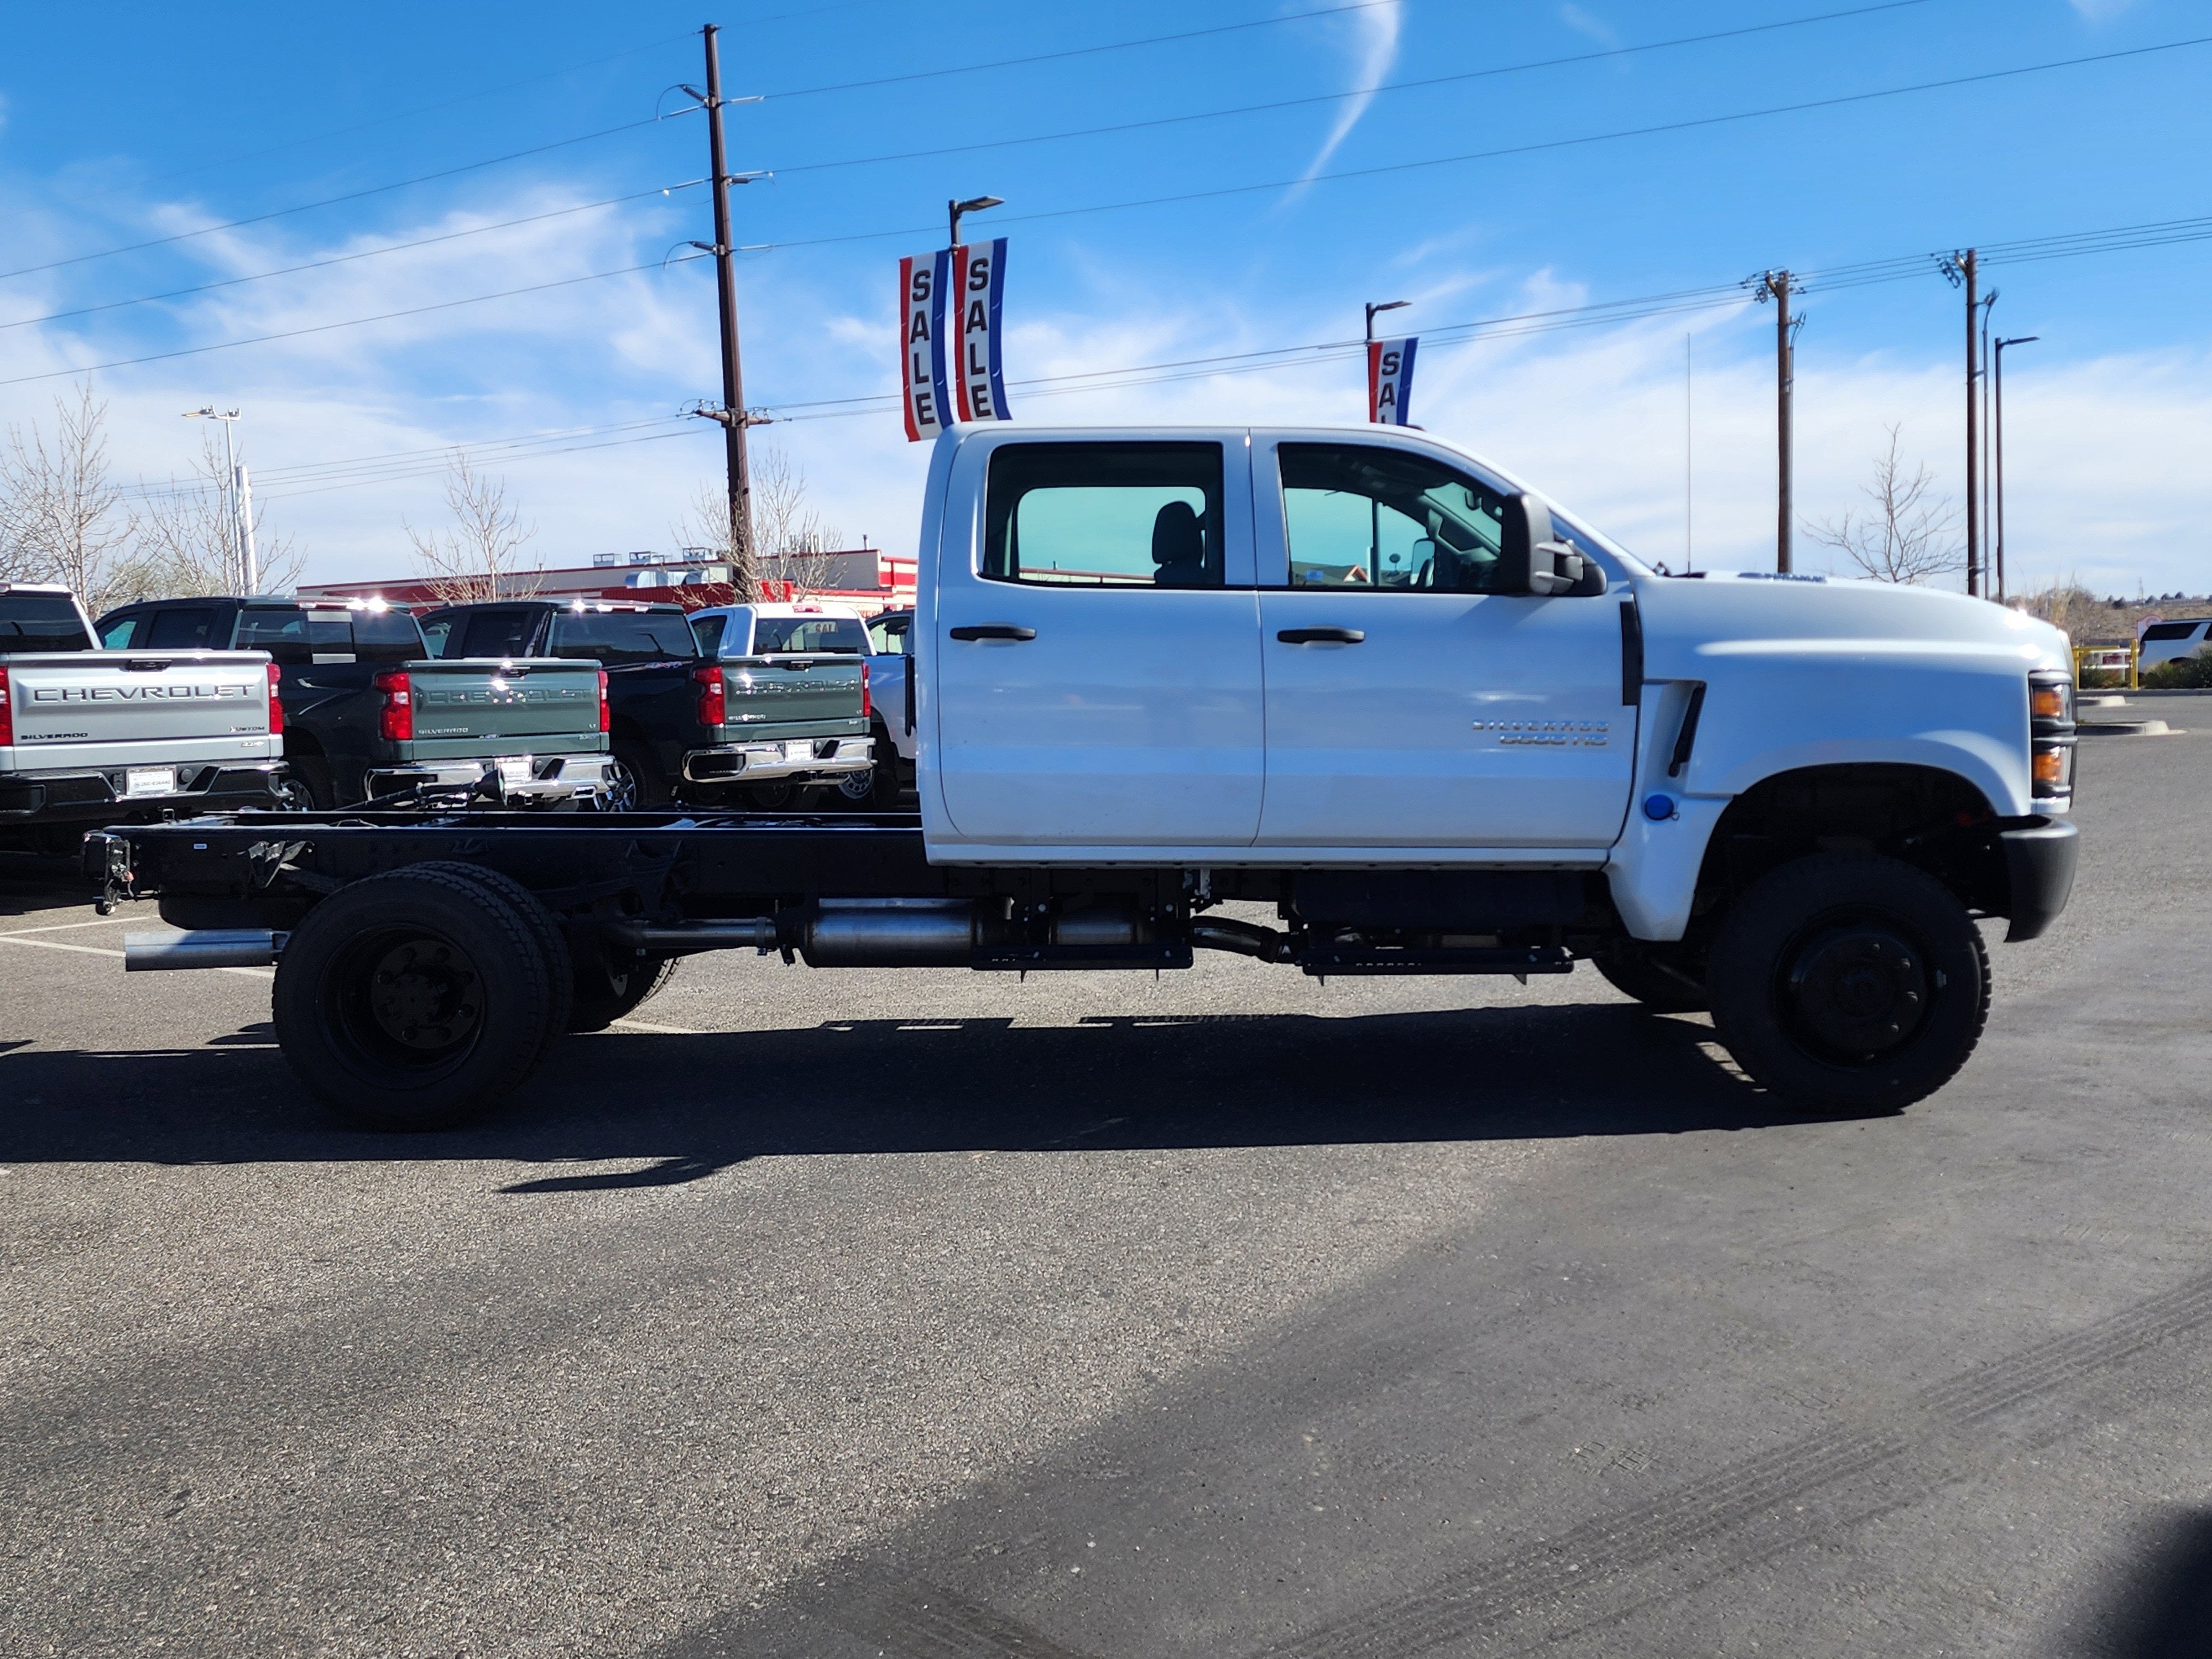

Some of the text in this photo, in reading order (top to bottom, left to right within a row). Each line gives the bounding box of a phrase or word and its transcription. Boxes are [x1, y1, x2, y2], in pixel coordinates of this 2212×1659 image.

[910, 269, 936, 425] SALE
[966, 258, 992, 417] SALE
[1379, 352, 1401, 424] SA
[34, 684, 255, 703] CHEVROLET
